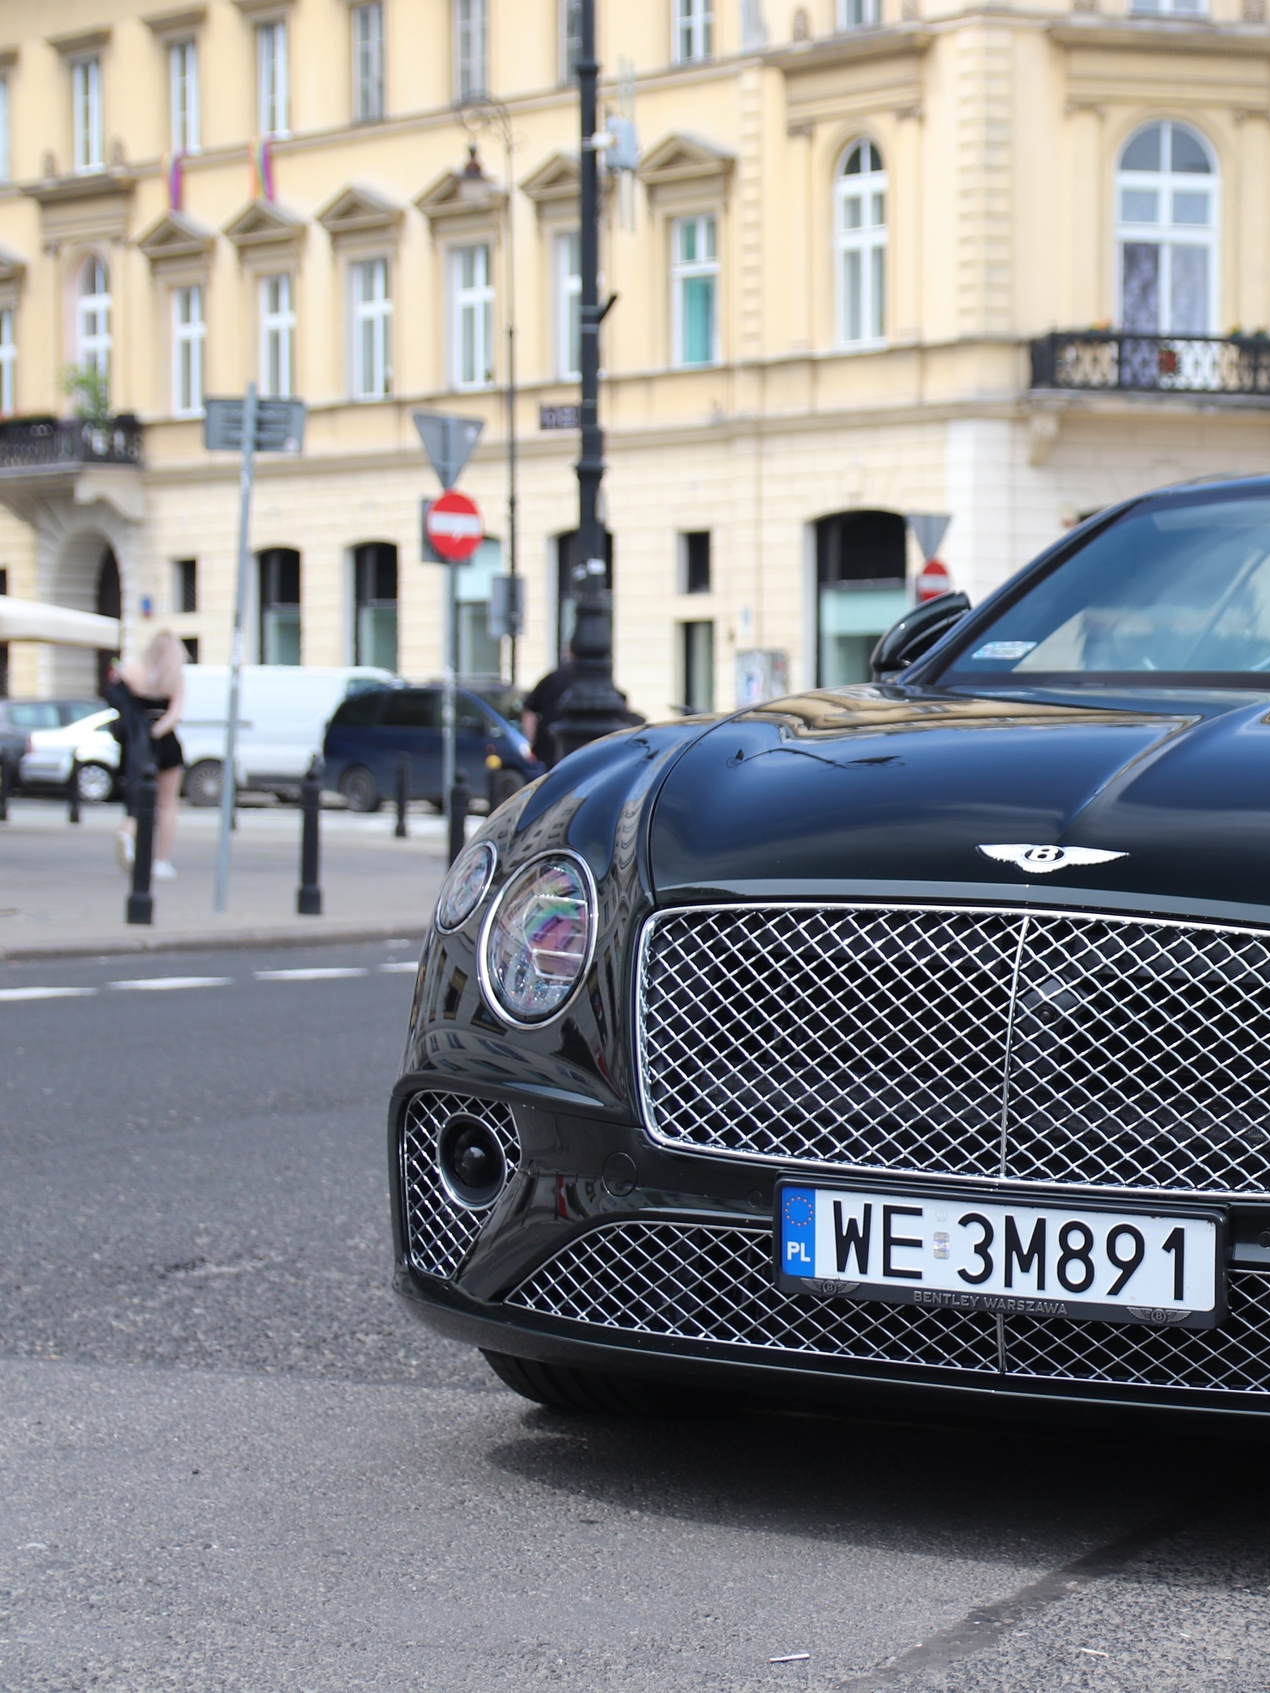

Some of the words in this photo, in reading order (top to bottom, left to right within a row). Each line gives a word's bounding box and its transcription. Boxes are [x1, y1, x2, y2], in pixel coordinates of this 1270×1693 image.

[787, 1241, 811, 1262] PL
[833, 1200, 923, 1279] WE
[957, 1212, 1185, 1301] 3M891
[913, 1290, 980, 1307] BENTLEY
[983, 1296, 1068, 1315] WARSZAWA
